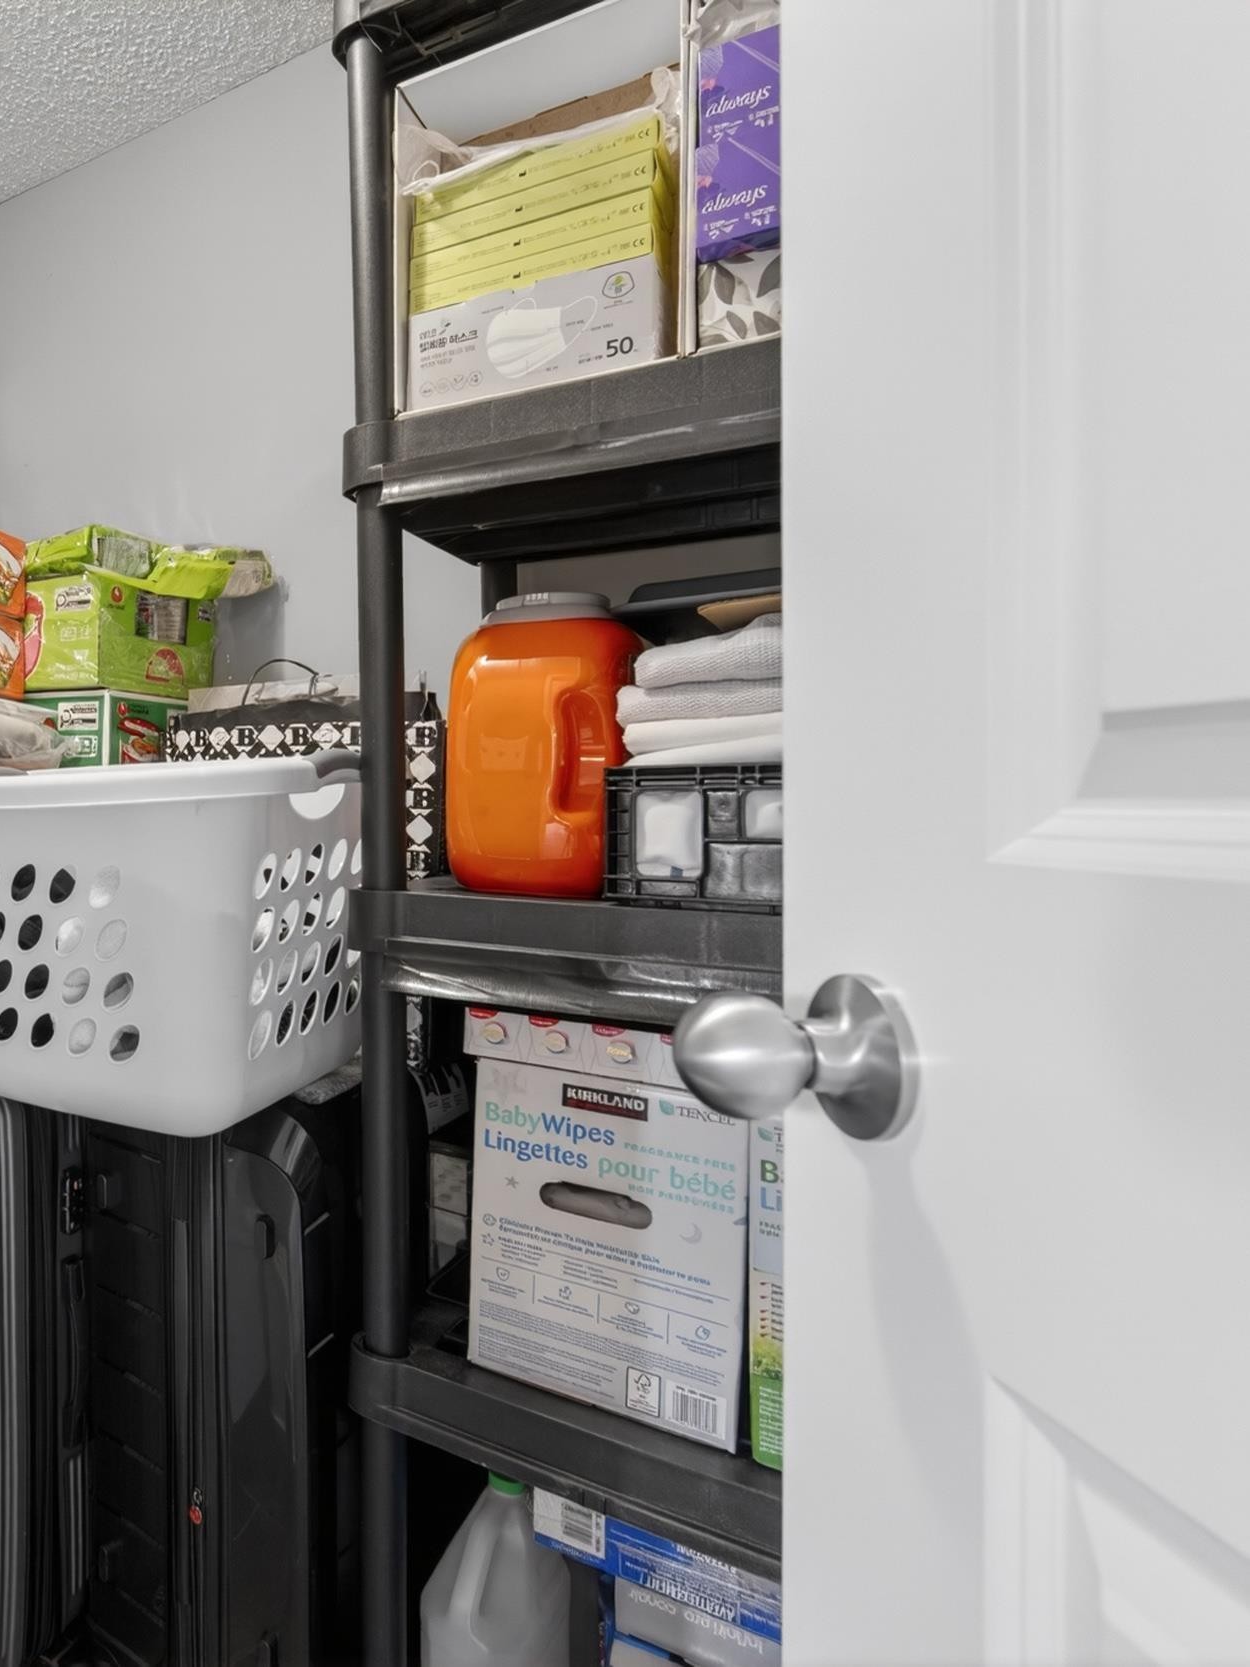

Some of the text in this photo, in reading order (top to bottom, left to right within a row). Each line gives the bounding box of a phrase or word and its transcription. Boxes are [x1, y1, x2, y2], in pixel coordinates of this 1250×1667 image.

[705, 84, 772, 119] always
[701, 184, 768, 215] always
[606, 336, 634, 358] 50
[566, 1087, 645, 1112] KIRKLAND
[485, 1101, 615, 1146] BabyWipes
[484, 1129, 736, 1201] Lingettes pour bébé
